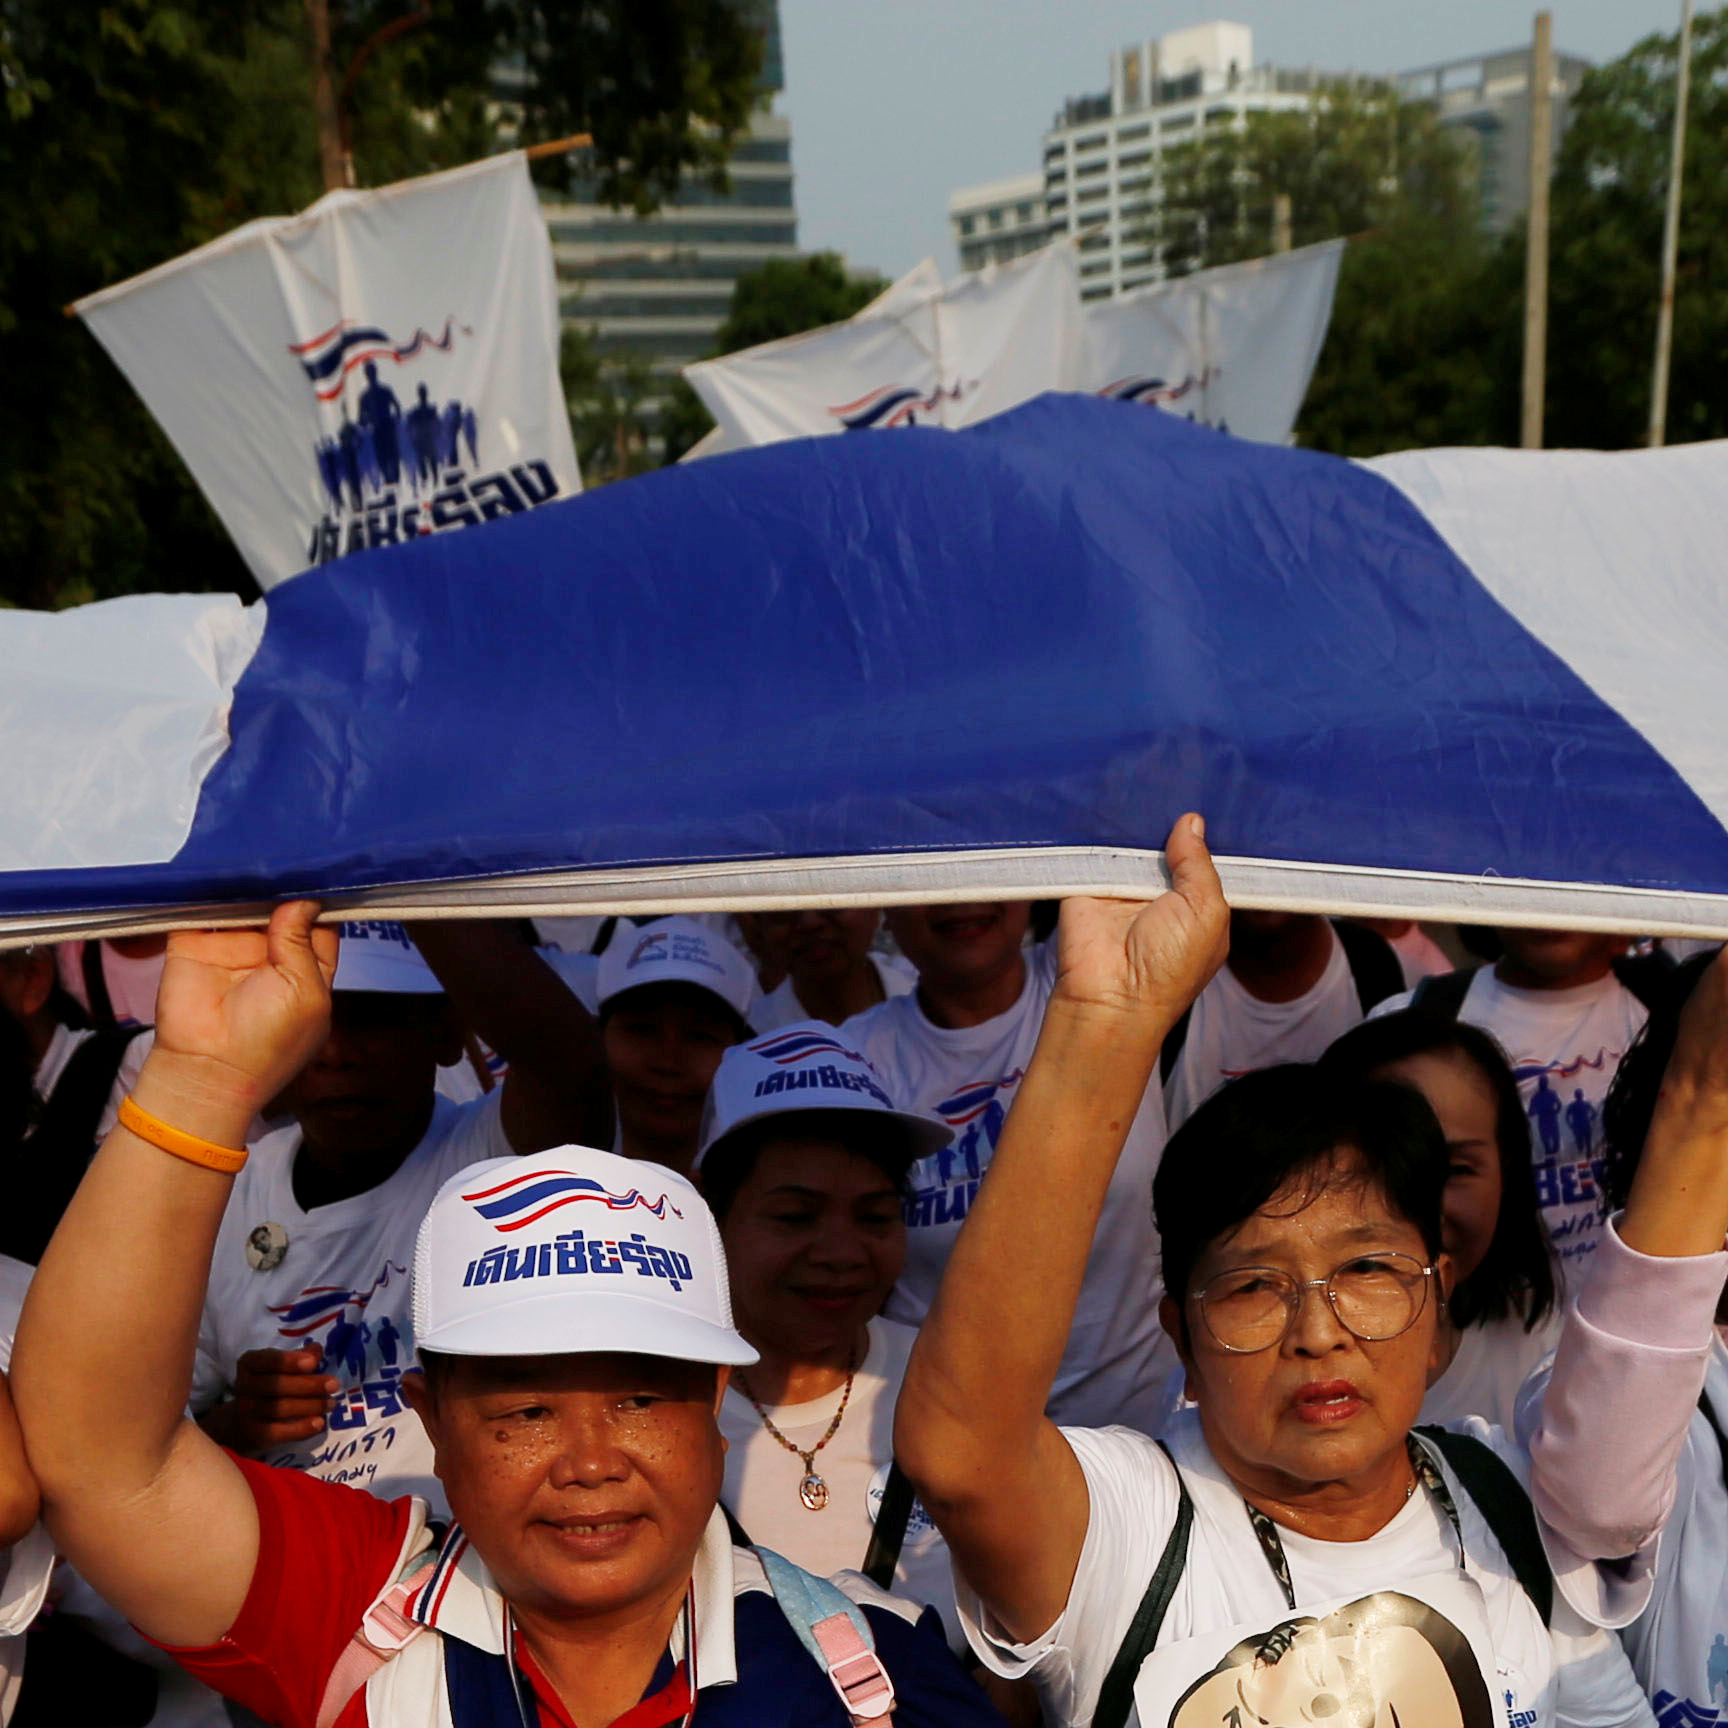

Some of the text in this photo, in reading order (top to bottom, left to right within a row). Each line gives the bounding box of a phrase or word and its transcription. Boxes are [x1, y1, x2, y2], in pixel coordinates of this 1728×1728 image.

[463, 1231, 693, 1293] เดินเชียร์ลุง
